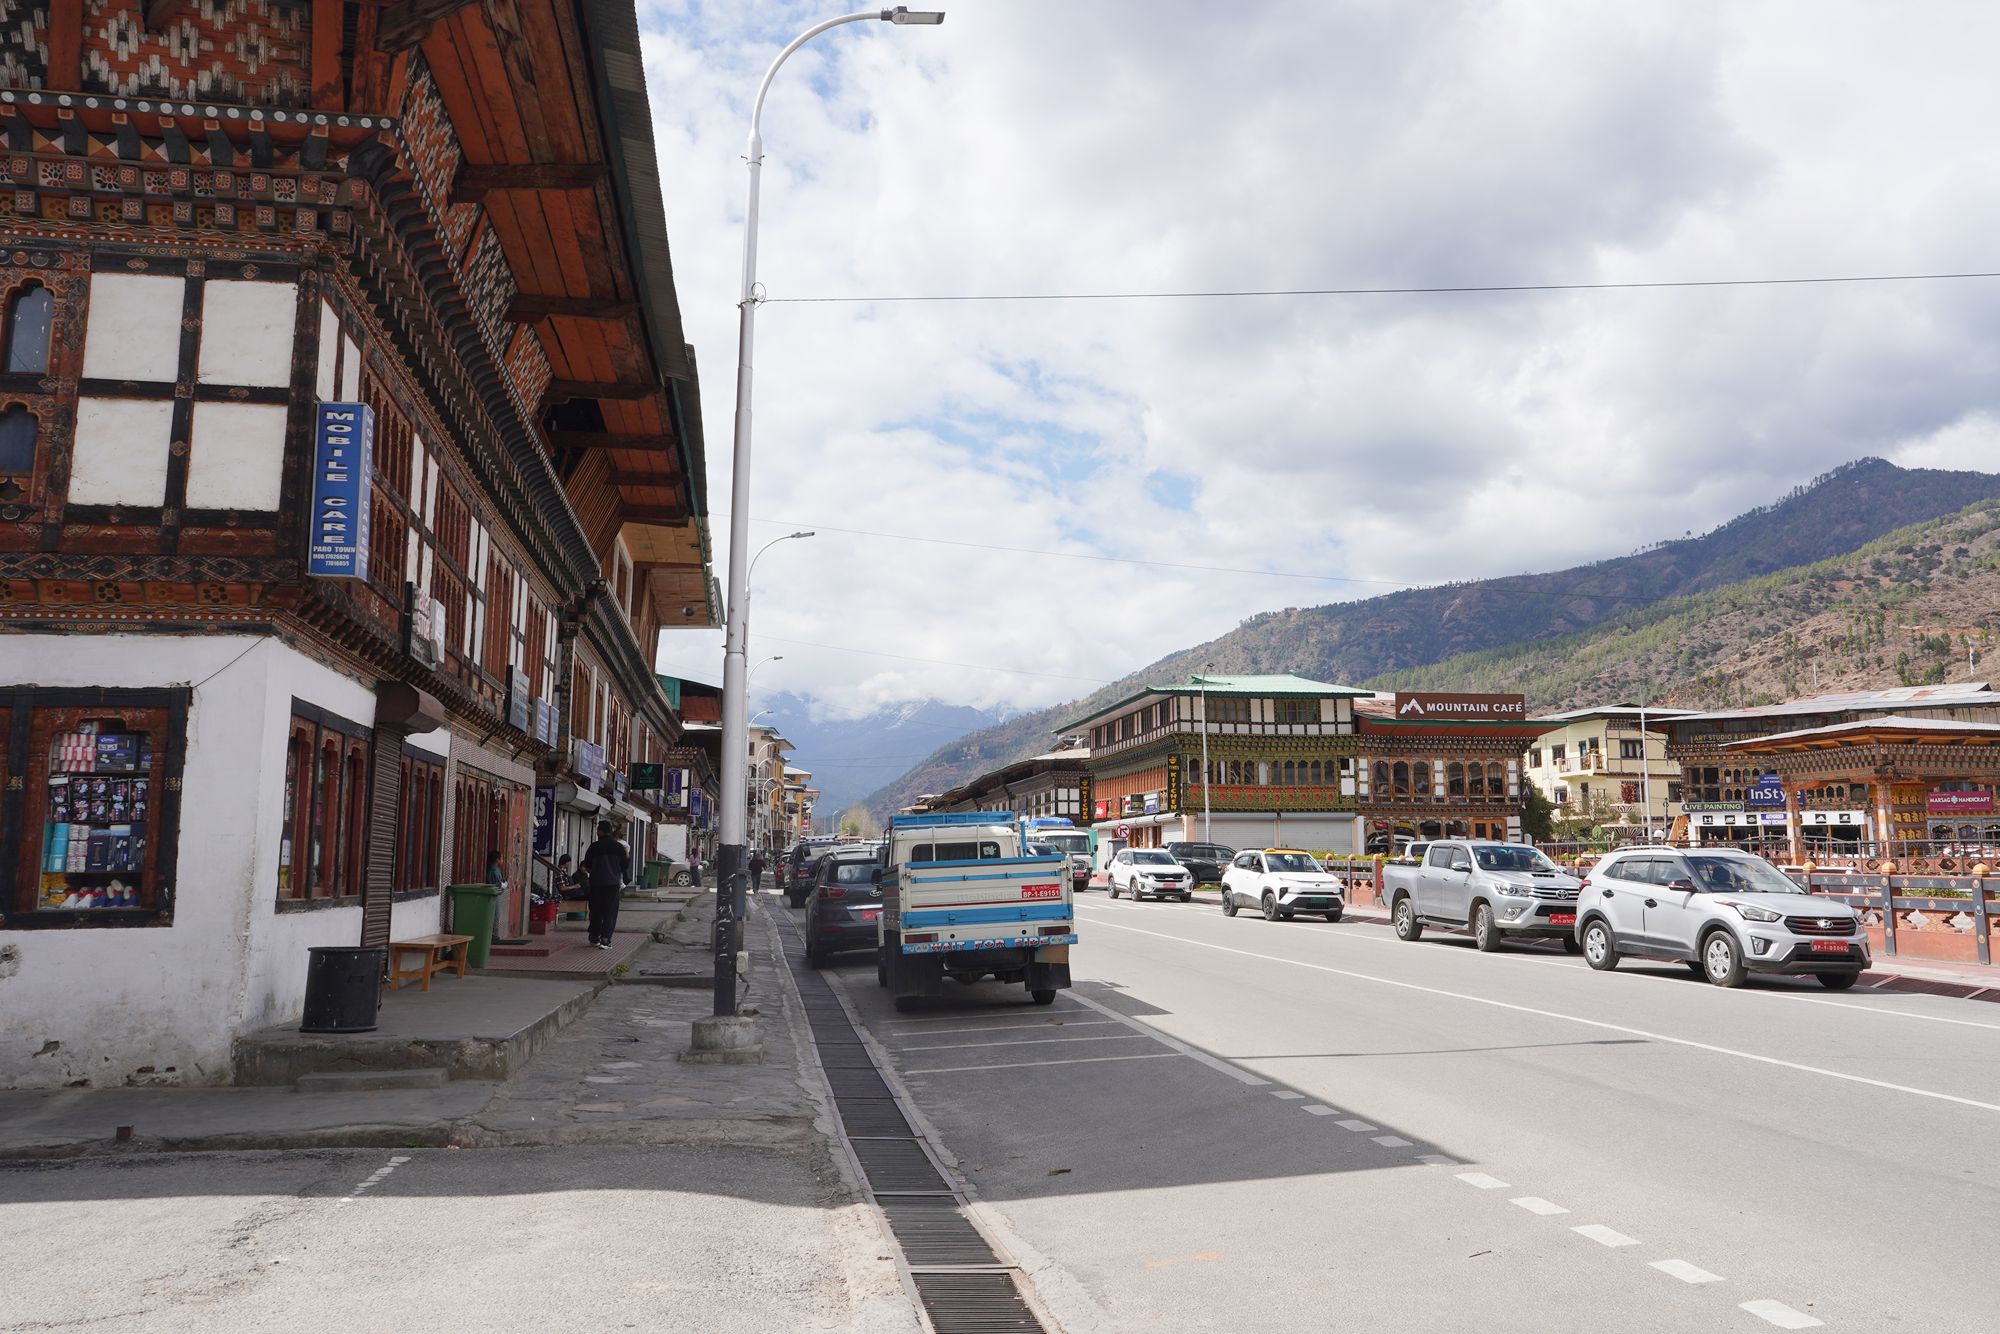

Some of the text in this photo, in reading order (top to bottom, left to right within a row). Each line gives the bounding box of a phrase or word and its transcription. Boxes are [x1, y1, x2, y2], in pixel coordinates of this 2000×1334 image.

[322, 412, 354, 544] MOBILE CARE
[1426, 702, 1523, 712] MOUNTAIN CAFÉ
[1170, 772, 1178, 811] KITCHEN
[1750, 787, 1801, 802] InStye
[1023, 890, 1060, 898] BP-1-E9151
[930, 941, 965, 951] WAIT
[973, 938, 1006, 949] FOR
[1014, 937, 1049, 947] SIDE
